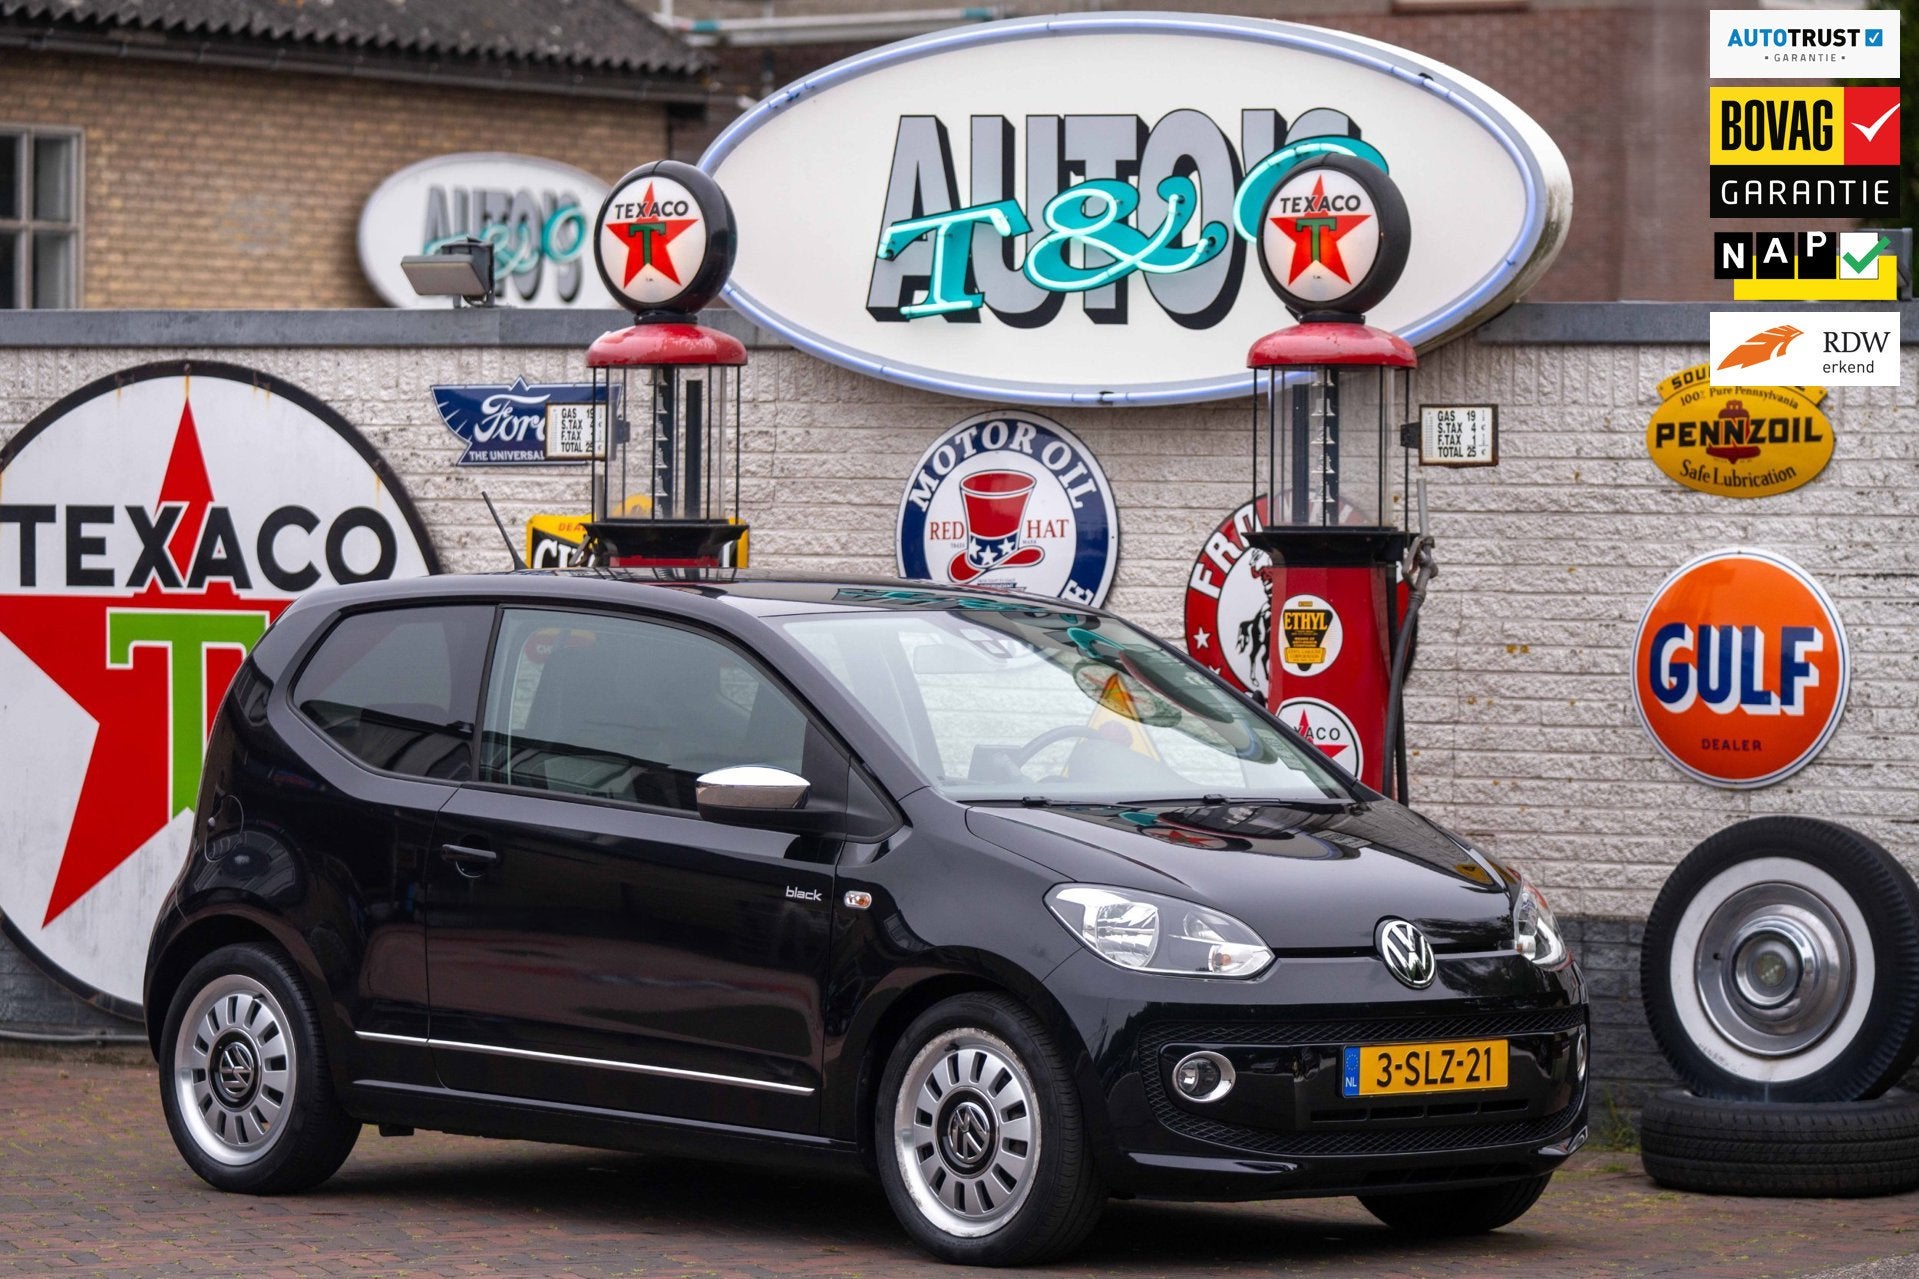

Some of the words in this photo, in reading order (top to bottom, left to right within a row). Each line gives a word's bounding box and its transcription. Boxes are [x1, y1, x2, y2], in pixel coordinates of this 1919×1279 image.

[615, 200, 689, 219] TEXACO
[1280, 195, 1361, 214] TEXACO
[1671, 367, 1711, 390] SOU
[1710, 386, 1733, 397] Pure
[1735, 386, 1799, 409] Pennsylvania
[561, 408, 577, 419] GAS
[1437, 410, 1455, 421] GAS
[1467, 410, 1476, 421] 19
[561, 420, 583, 430] S.TAX
[1437, 422, 1463, 434] S.TAX
[1471, 423, 1477, 433] 4
[1655, 416, 1823, 448] PENNZOIL
[561, 431, 581, 441] F.TAX
[1437, 434, 1462, 445] F.TAX
[469, 451, 488, 461] THE
[490, 450, 545, 461] UNIVERSAL
[561, 442, 583, 452] TOTAL
[1437, 446, 1464, 458] TOTAL
[1467, 446, 1477, 458] 25
[909, 420, 1037, 512] MOTOR
[1042, 440, 1097, 510] OIL
[1679, 459, 1711, 484] Safe
[1713, 465, 1798, 488] Lubrication
[929, 521, 965, 541] RED
[1026, 518, 1070, 538] HAT
[0, 504, 398, 592] TEXACO
[1284, 611, 1328, 631] ETHYL
[1649, 622, 1824, 717] GULF
[1701, 738, 1762, 751] DEALER
[785, 885, 823, 902] black
[1376, 1047, 1492, 1088] 3-SLZ-21
[1345, 1077, 1358, 1088] NL
